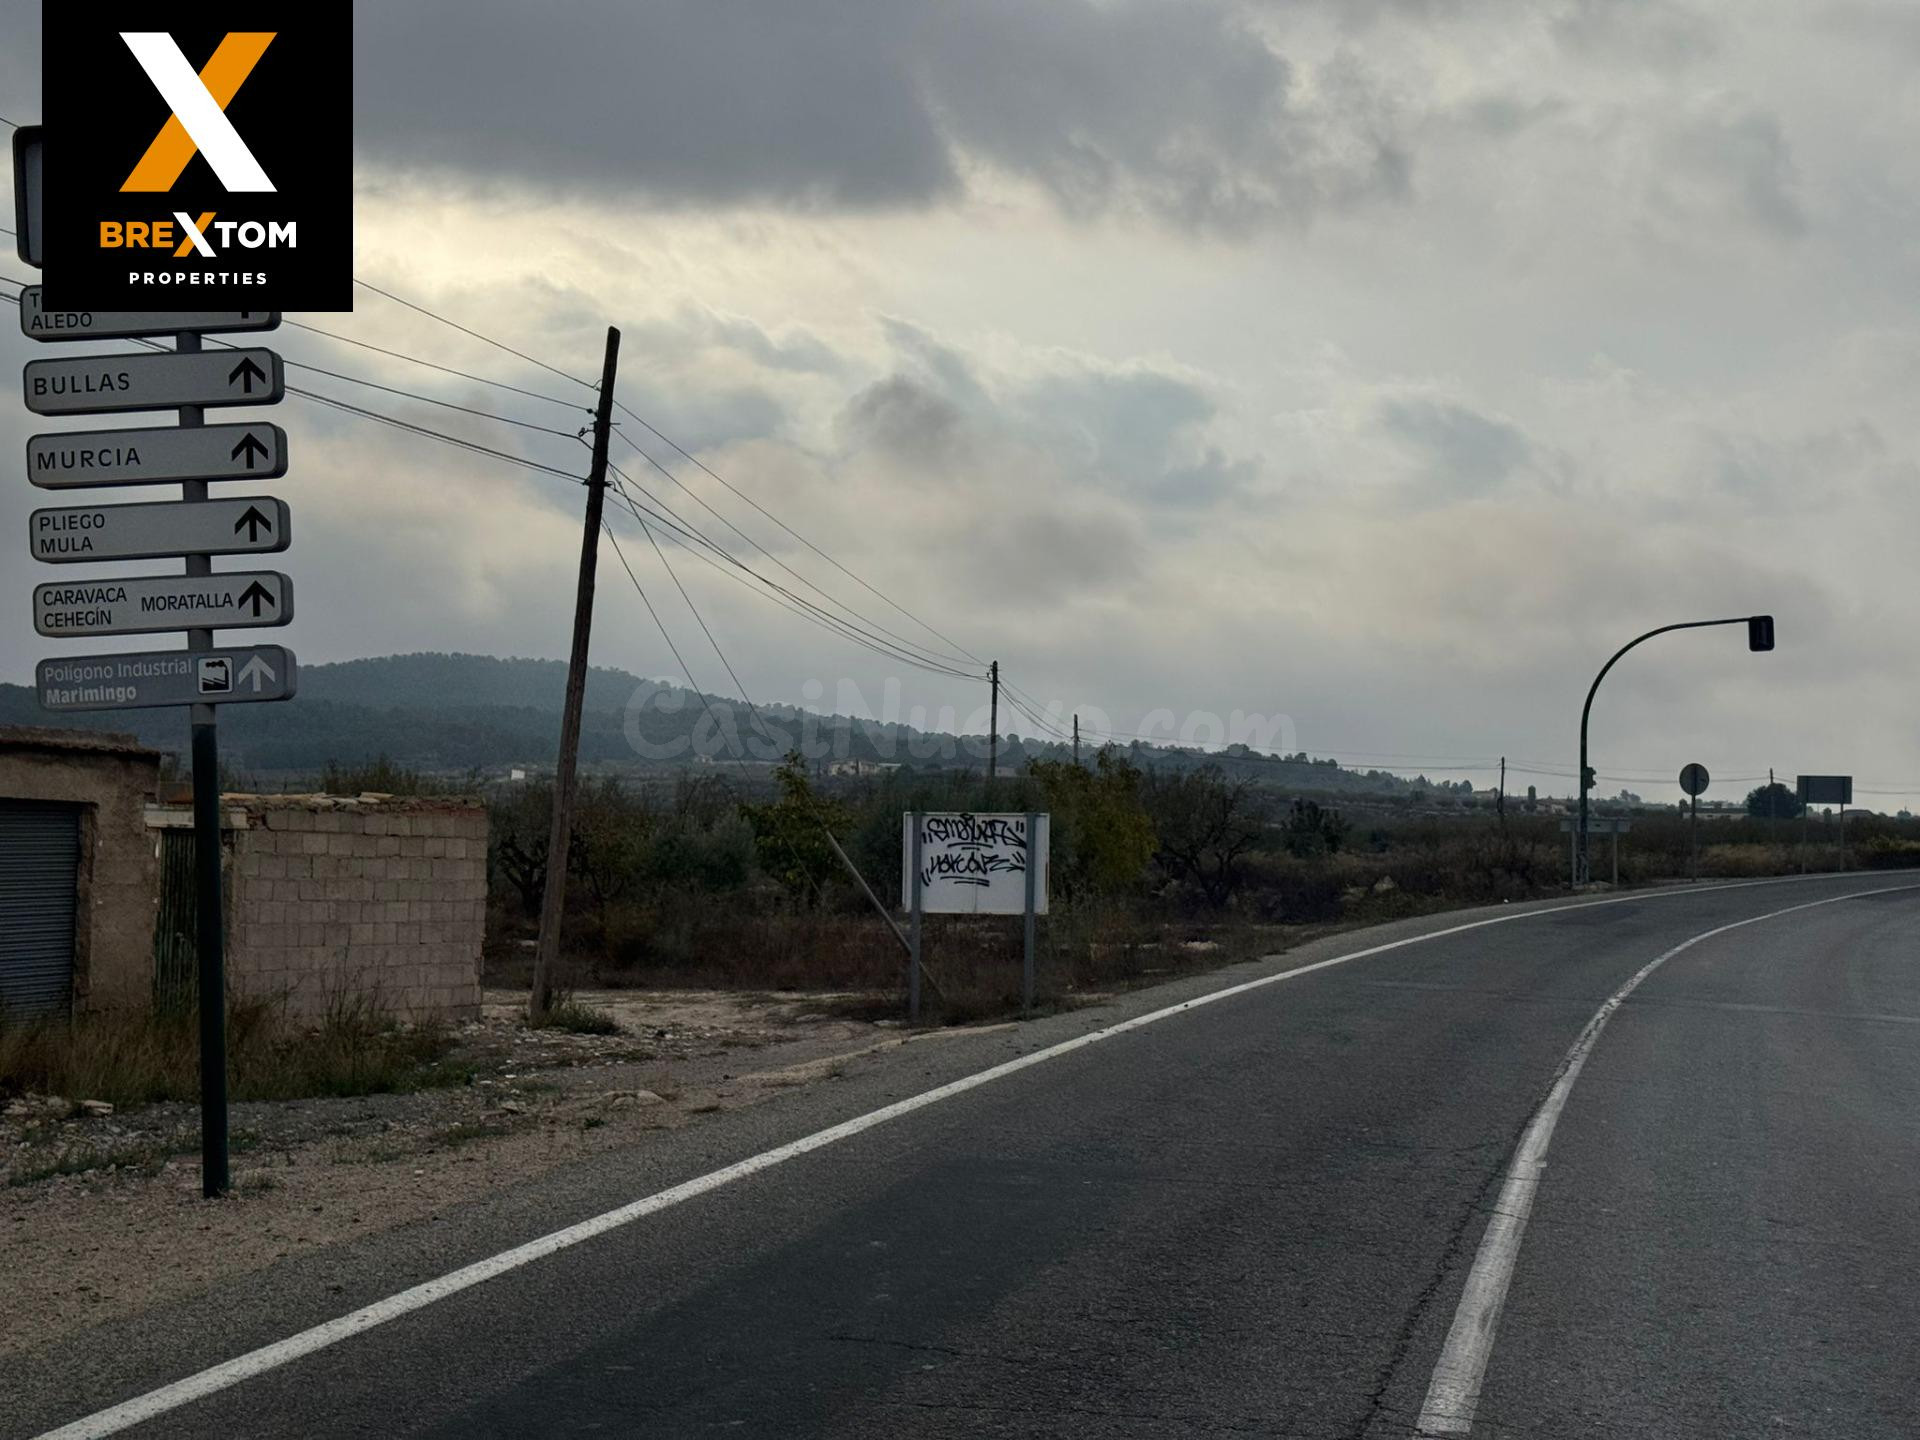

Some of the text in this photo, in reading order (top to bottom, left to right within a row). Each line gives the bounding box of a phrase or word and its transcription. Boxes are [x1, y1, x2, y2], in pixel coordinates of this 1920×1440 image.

[31, 312, 93, 330] ALEDO
[34, 373, 130, 395] BULLAS
[37, 447, 141, 470] MURCIA
[39, 513, 105, 531] PLIEGO
[40, 536, 93, 553] MULA
[43, 587, 127, 606] CARAVACA
[141, 592, 233, 612] MORATALLA
[44, 607, 112, 628] CEHEGÍN
[45, 657, 192, 683] Polígono Industrial
[46, 684, 137, 705] Marimingo
